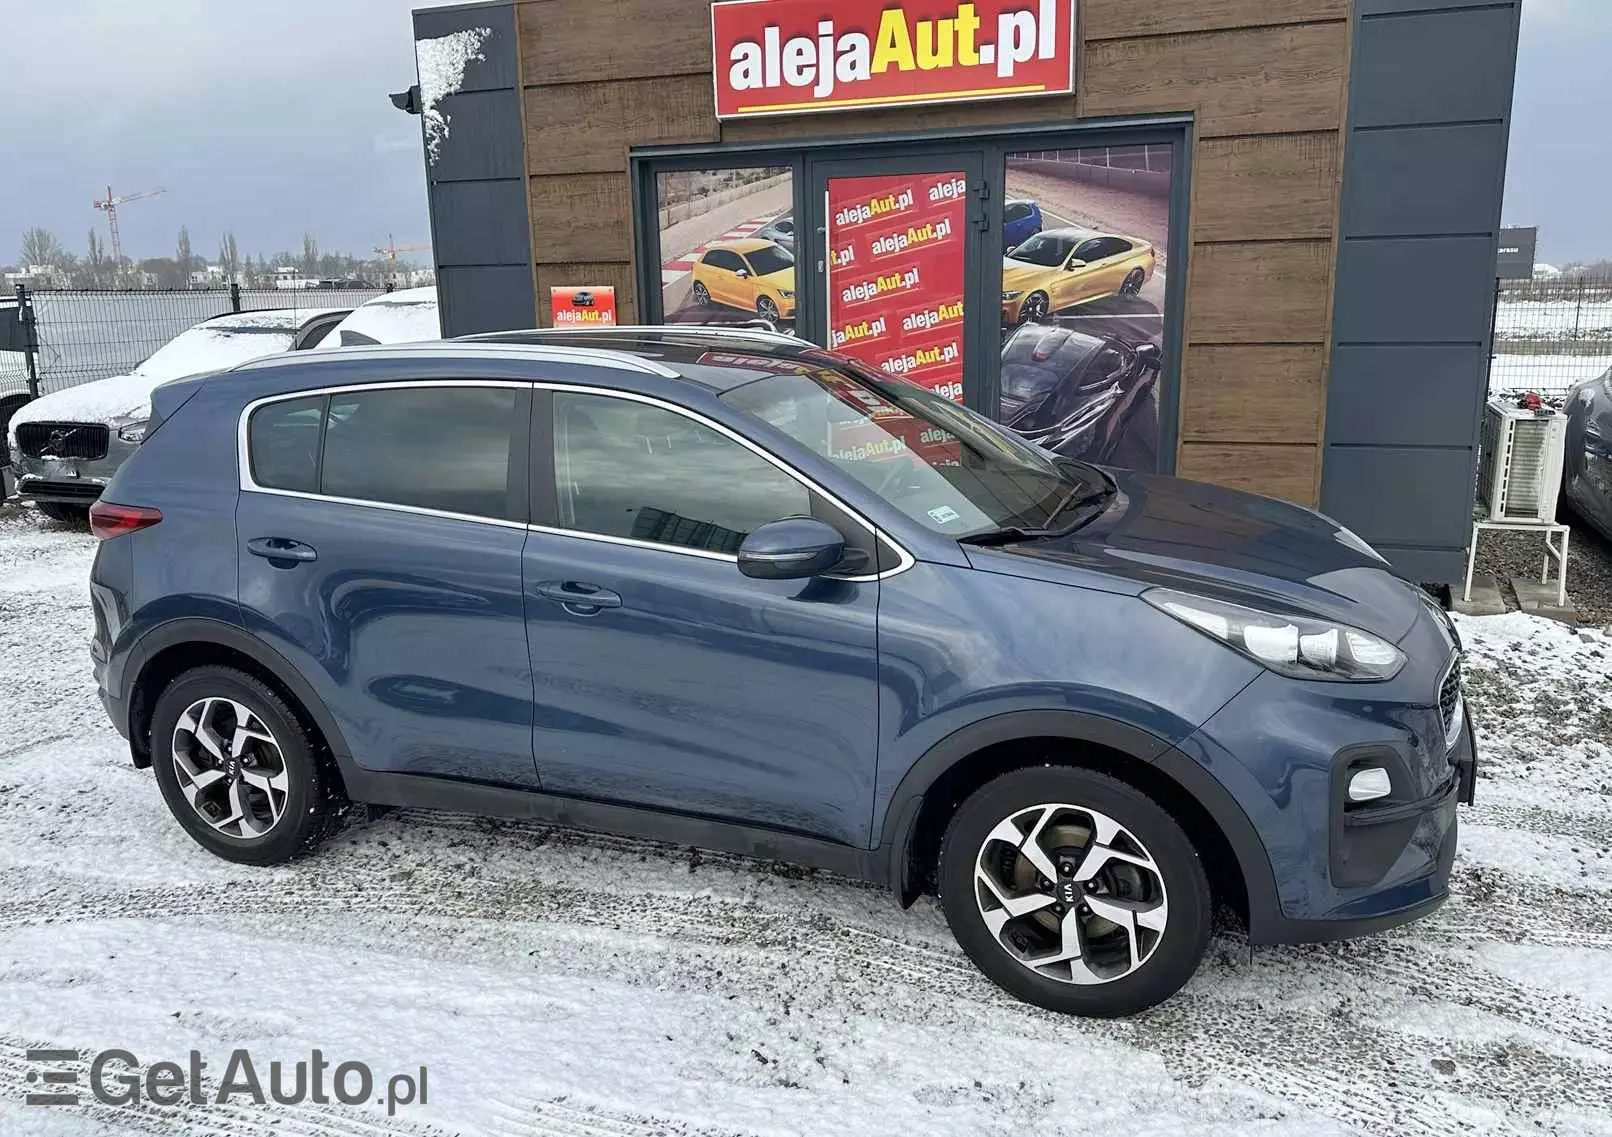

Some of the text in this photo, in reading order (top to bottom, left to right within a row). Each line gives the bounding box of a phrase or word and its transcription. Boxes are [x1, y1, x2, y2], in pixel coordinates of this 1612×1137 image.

[729, 0, 1056, 98] alejaAut.pl
[836, 189, 913, 225] alejaAut.pl
[872, 219, 951, 254] alejaAut.pl
[842, 268, 919, 301] alejaAut.pl
[556, 309, 612, 324] alejaAut.pl
[880, 342, 959, 374] alejaAut.pl
